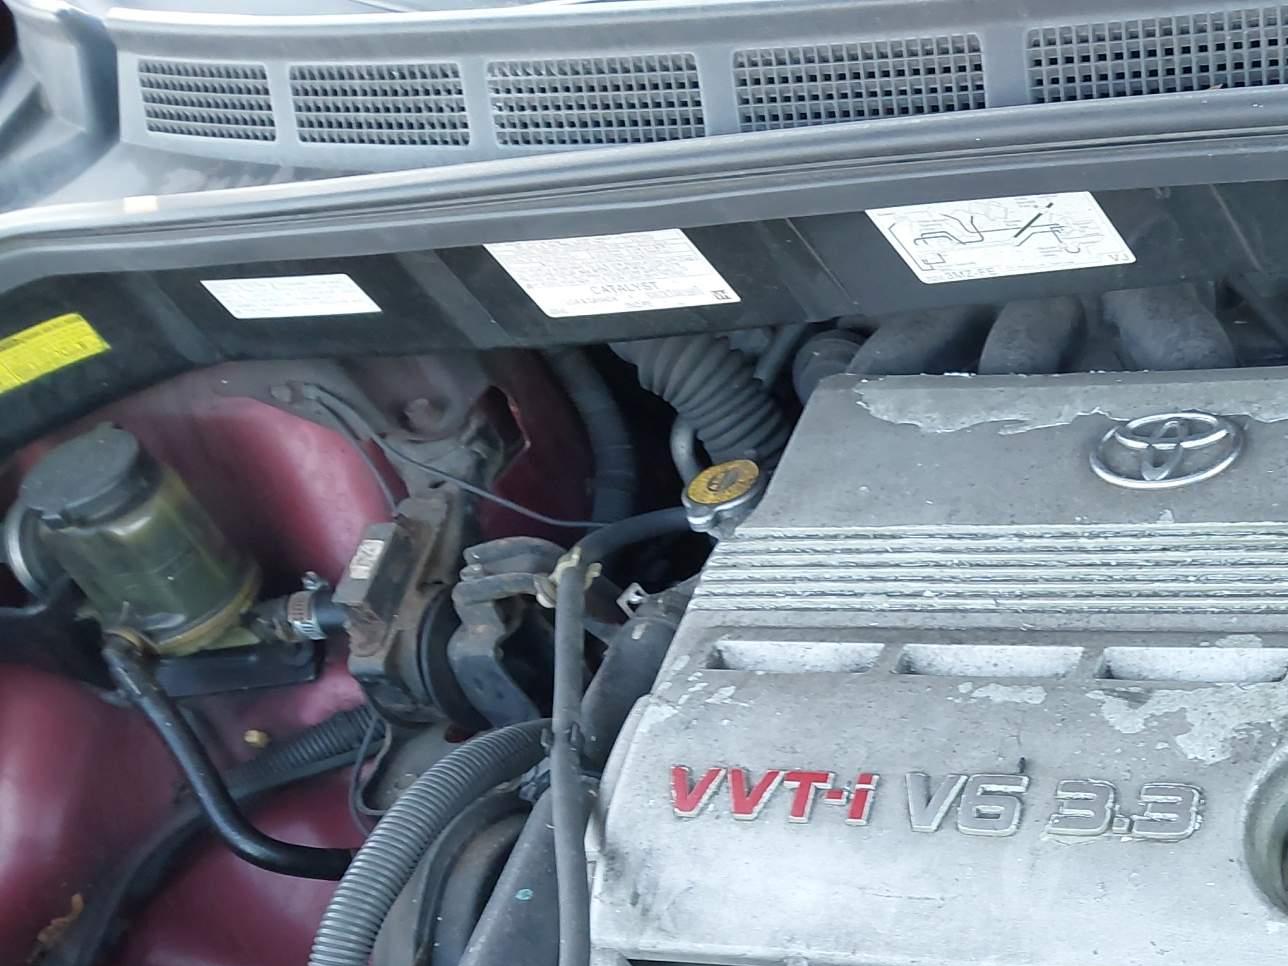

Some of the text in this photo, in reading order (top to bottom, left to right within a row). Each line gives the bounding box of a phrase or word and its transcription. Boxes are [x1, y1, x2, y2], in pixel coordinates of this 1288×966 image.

[590, 281, 660, 295] CATALYST
[669, 764, 1205, 842] VVT-i V6 3.3
